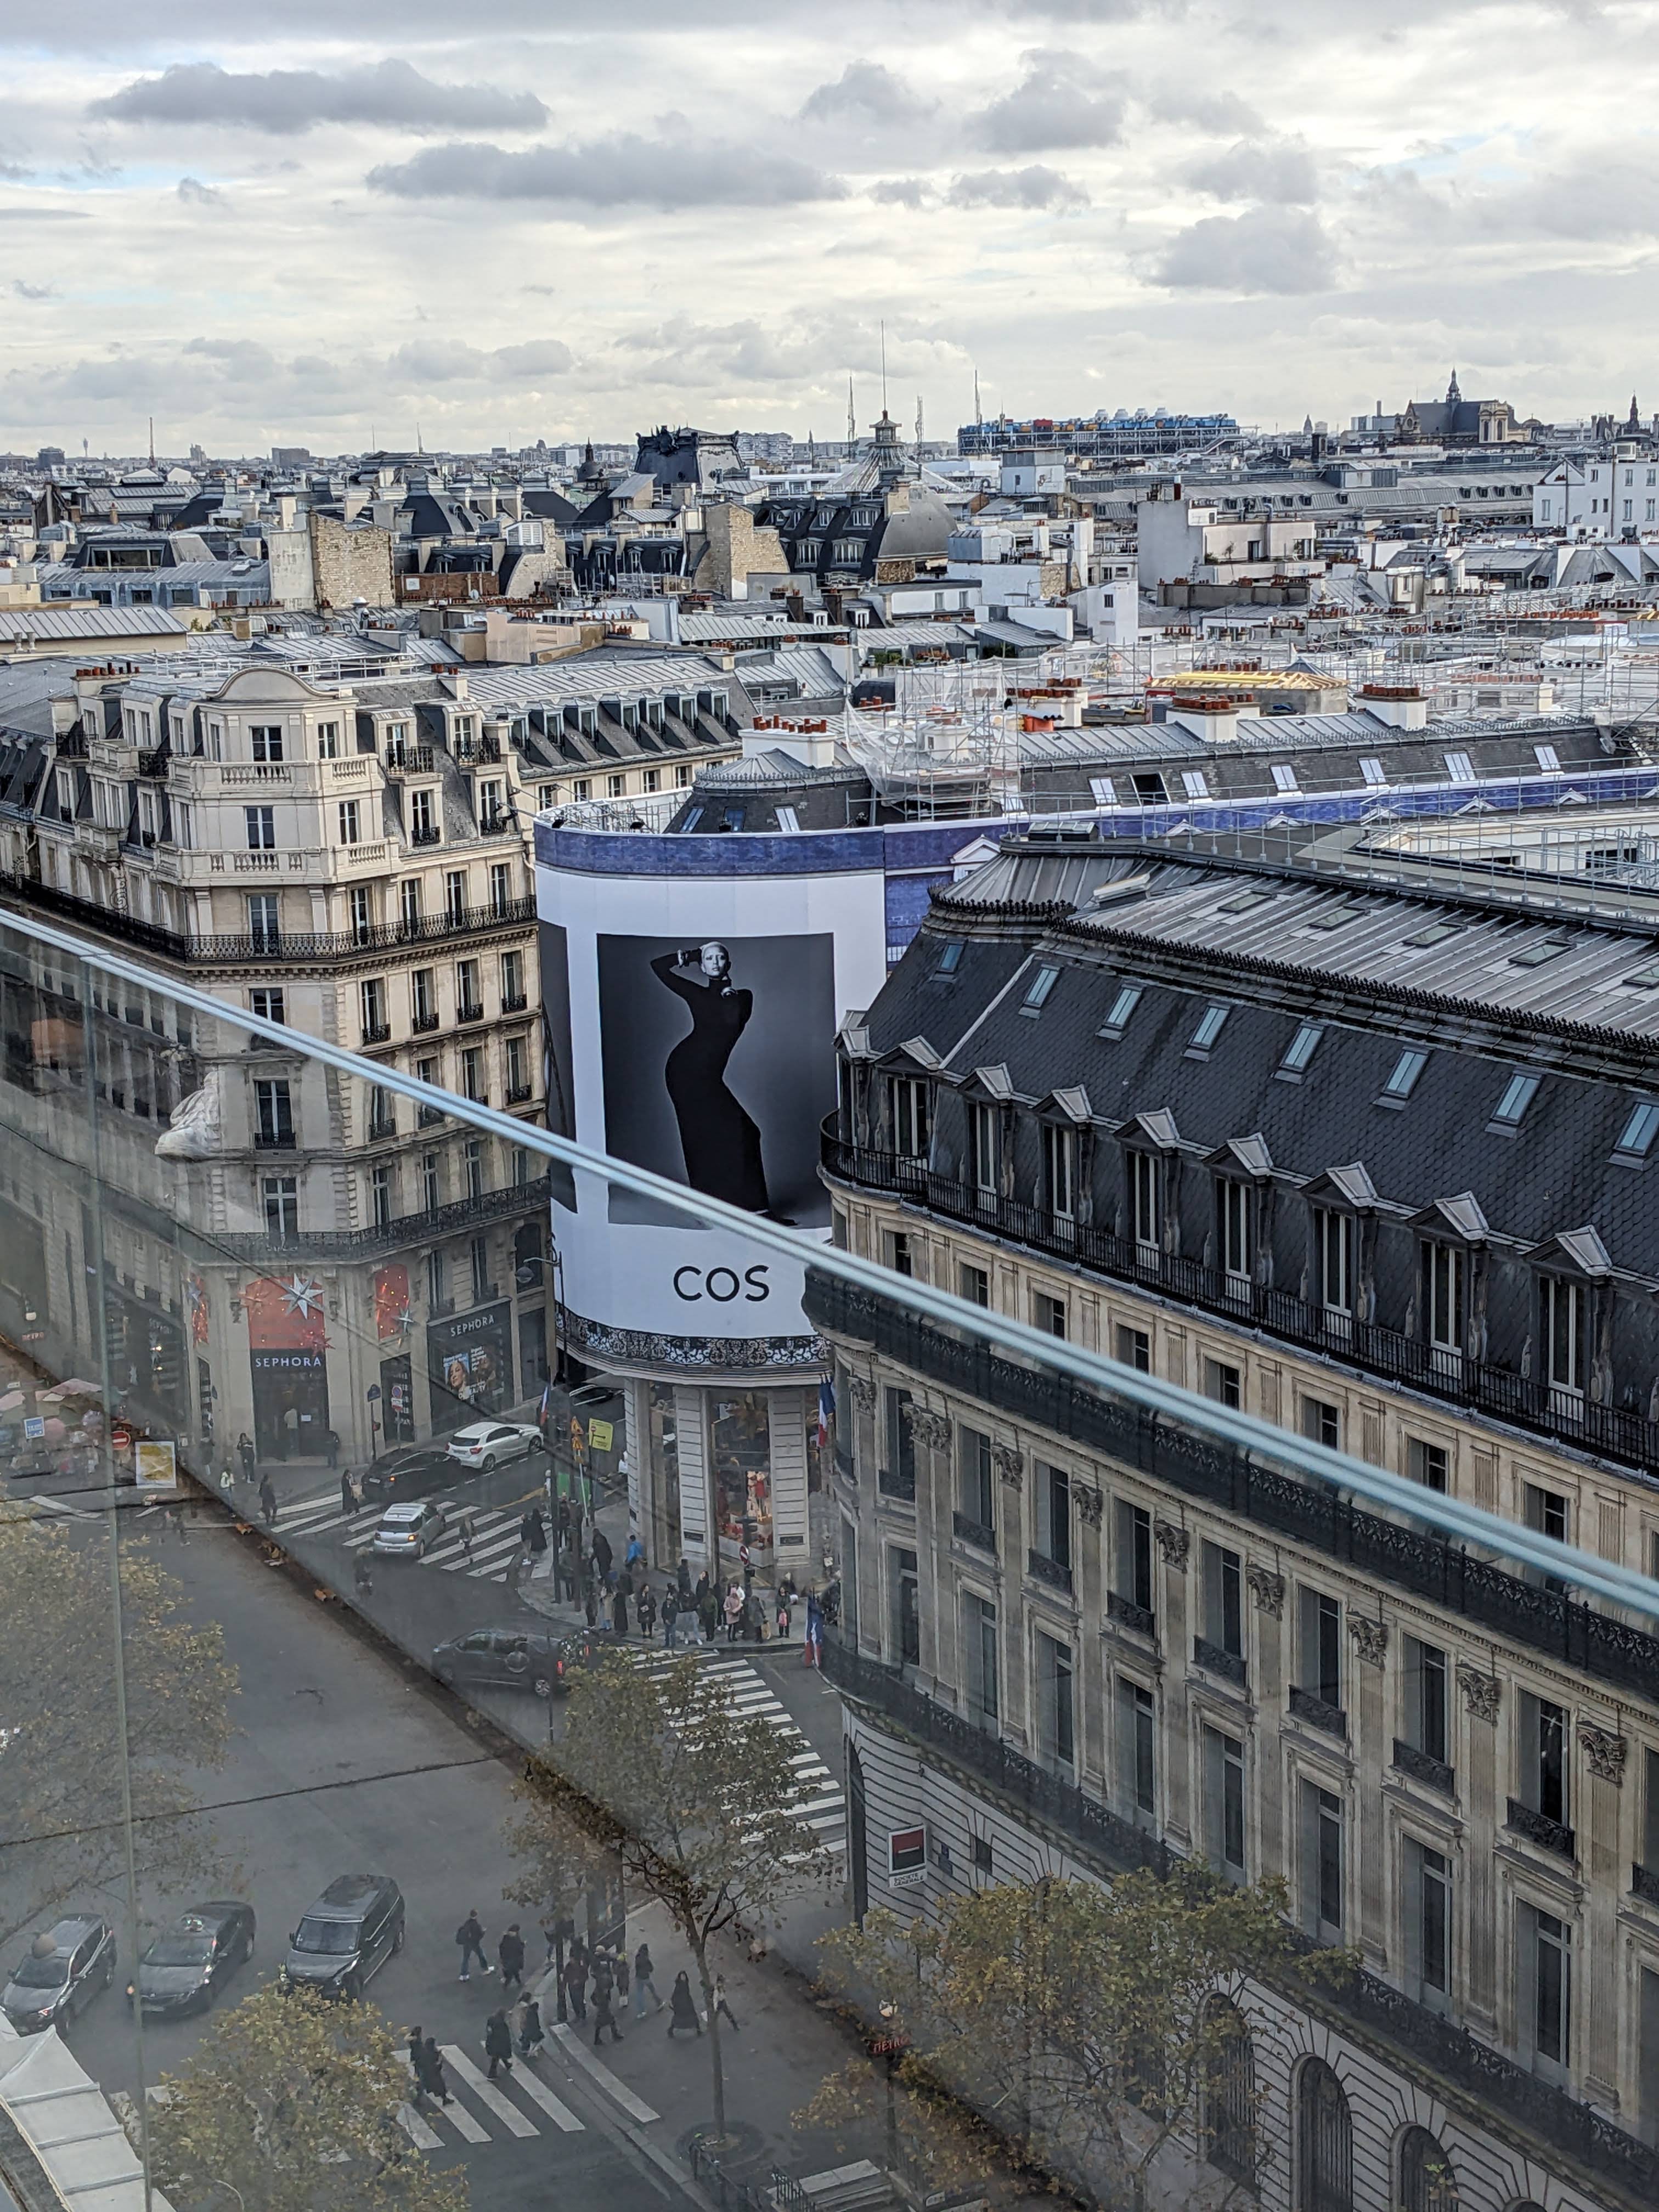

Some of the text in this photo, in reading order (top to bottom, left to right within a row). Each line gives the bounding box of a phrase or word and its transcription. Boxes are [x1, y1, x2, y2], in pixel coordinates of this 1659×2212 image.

[673, 1265, 770, 1302] COS
[450, 1314, 494, 1337] SEPHORA
[255, 1357, 321, 1368] SEPHORA
